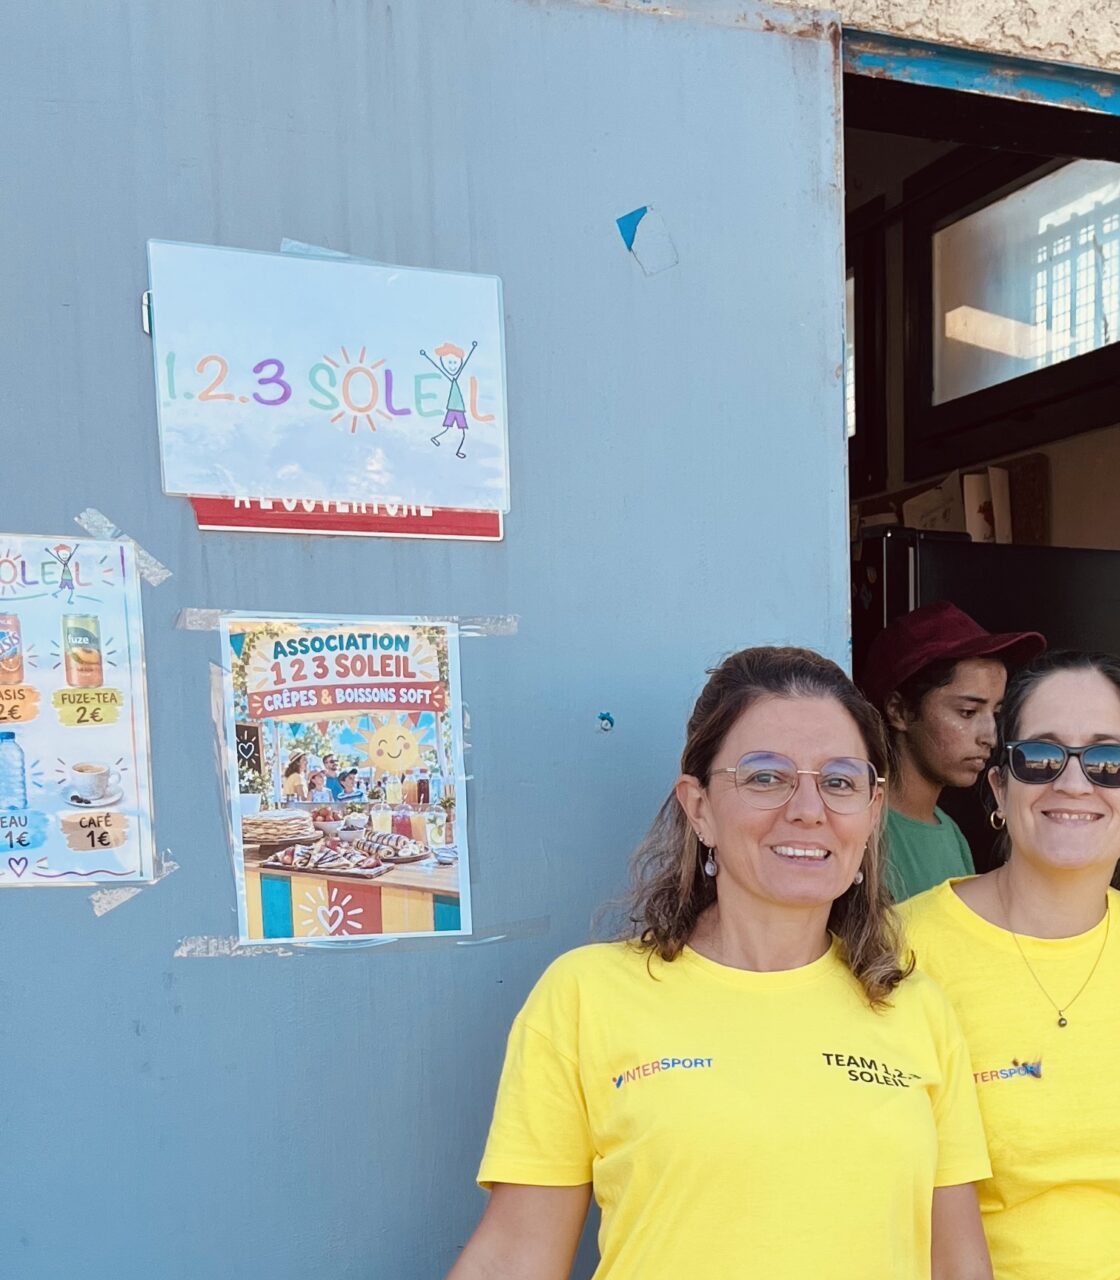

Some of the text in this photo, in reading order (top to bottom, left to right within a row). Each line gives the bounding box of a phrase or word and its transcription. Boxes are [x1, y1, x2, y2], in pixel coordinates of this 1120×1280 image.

[165, 351, 292, 407] 1.2.3
[67, 633, 90, 645] fuze
[272, 632, 411, 661] ASSOCIATION
[270, 653, 417, 687] 1 2 3 SOLEIL
[60, 692, 118, 705] FUZE-TEA
[263, 687, 432, 712] CRÊPES & BOISSONS SOFT
[75, 705, 104, 724] 2€
[0, 815, 28, 829] EAU
[79, 812, 113, 829] CAFÉ
[4, 830, 31, 849] 1€
[86, 830, 111, 848] 1€
[622, 1057, 713, 1084] INTERSPORT
[821, 1052, 879, 1072] TEAM
[847, 1069, 910, 1088] SOLEIL
